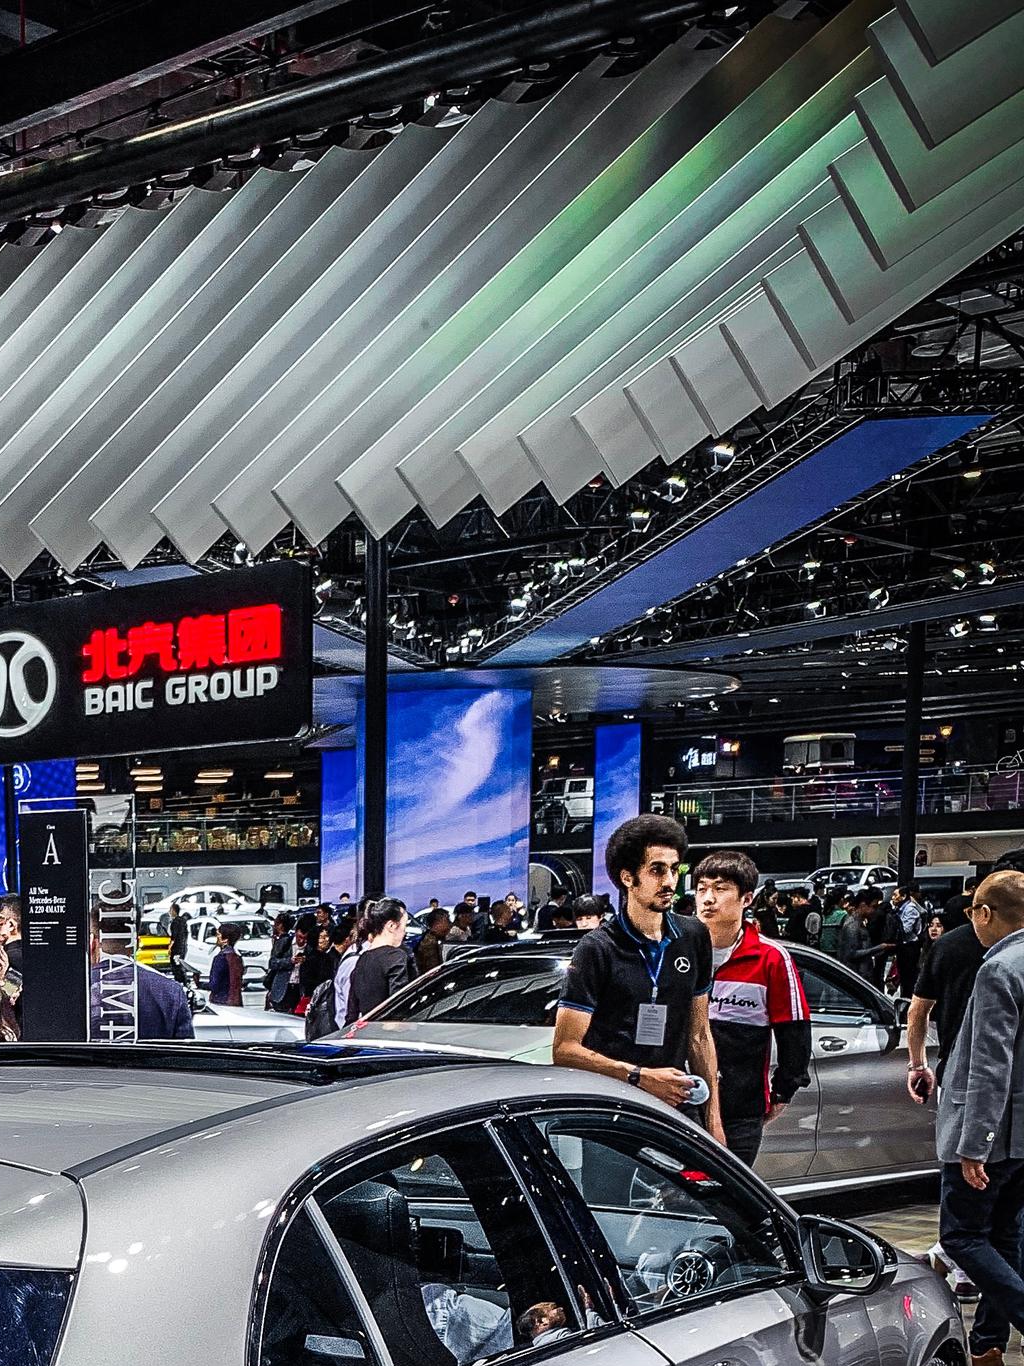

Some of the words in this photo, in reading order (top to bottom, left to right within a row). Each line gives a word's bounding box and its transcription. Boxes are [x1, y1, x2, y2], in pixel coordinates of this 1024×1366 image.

[82, 604, 282, 682] 北汽集团
[85, 679, 154, 716] BAIC
[165, 665, 279, 705] GROUP
[42, 832, 62, 865] A
